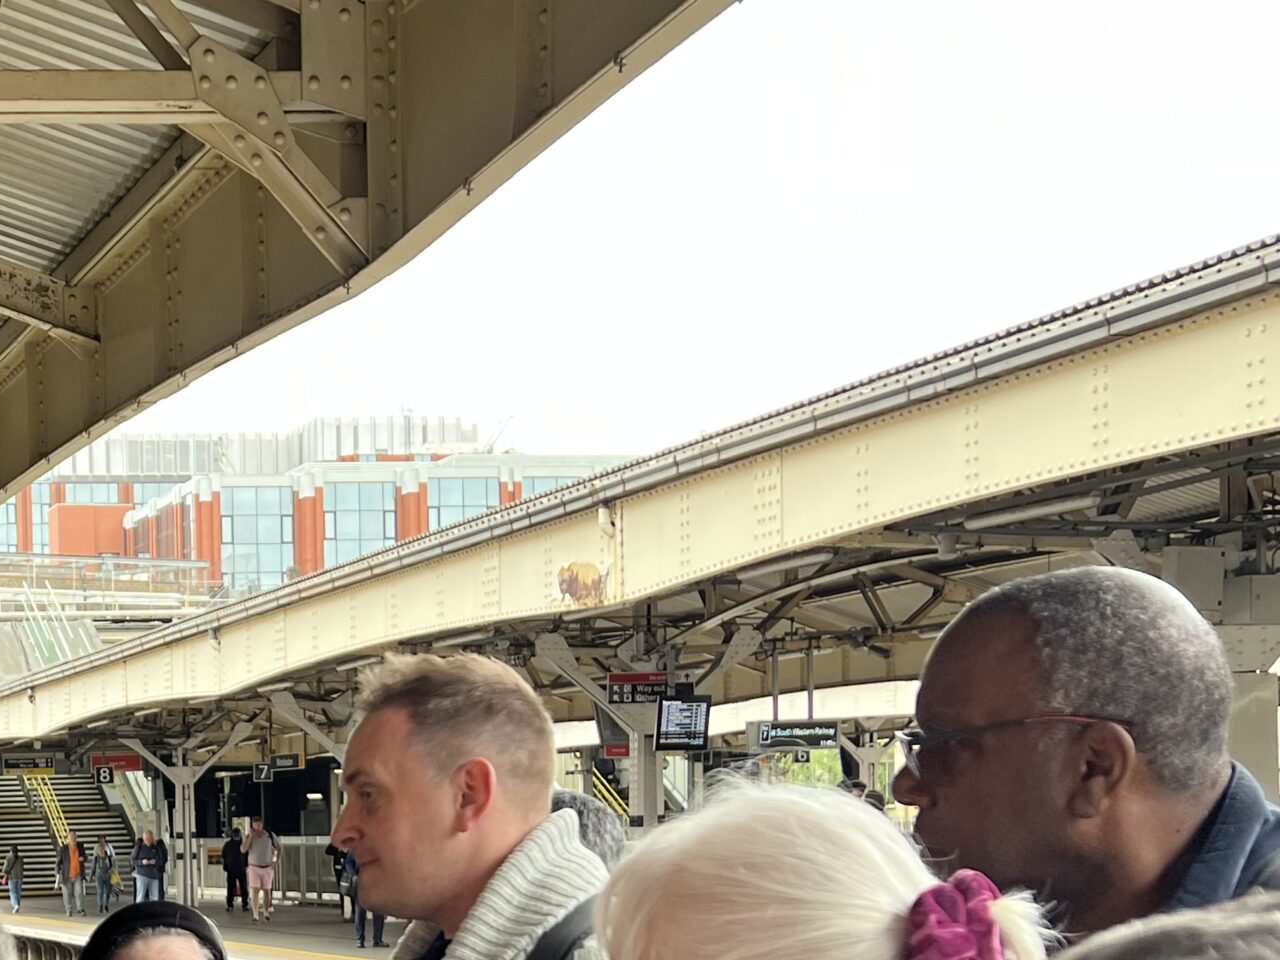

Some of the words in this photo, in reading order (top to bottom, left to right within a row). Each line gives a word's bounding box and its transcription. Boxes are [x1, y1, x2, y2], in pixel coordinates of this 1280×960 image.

[636, 684, 652, 693] Way
[653, 684, 665, 692] out
[797, 750, 807, 761] 6
[99, 767, 111, 782] 8
[258, 764, 269, 779] 7
